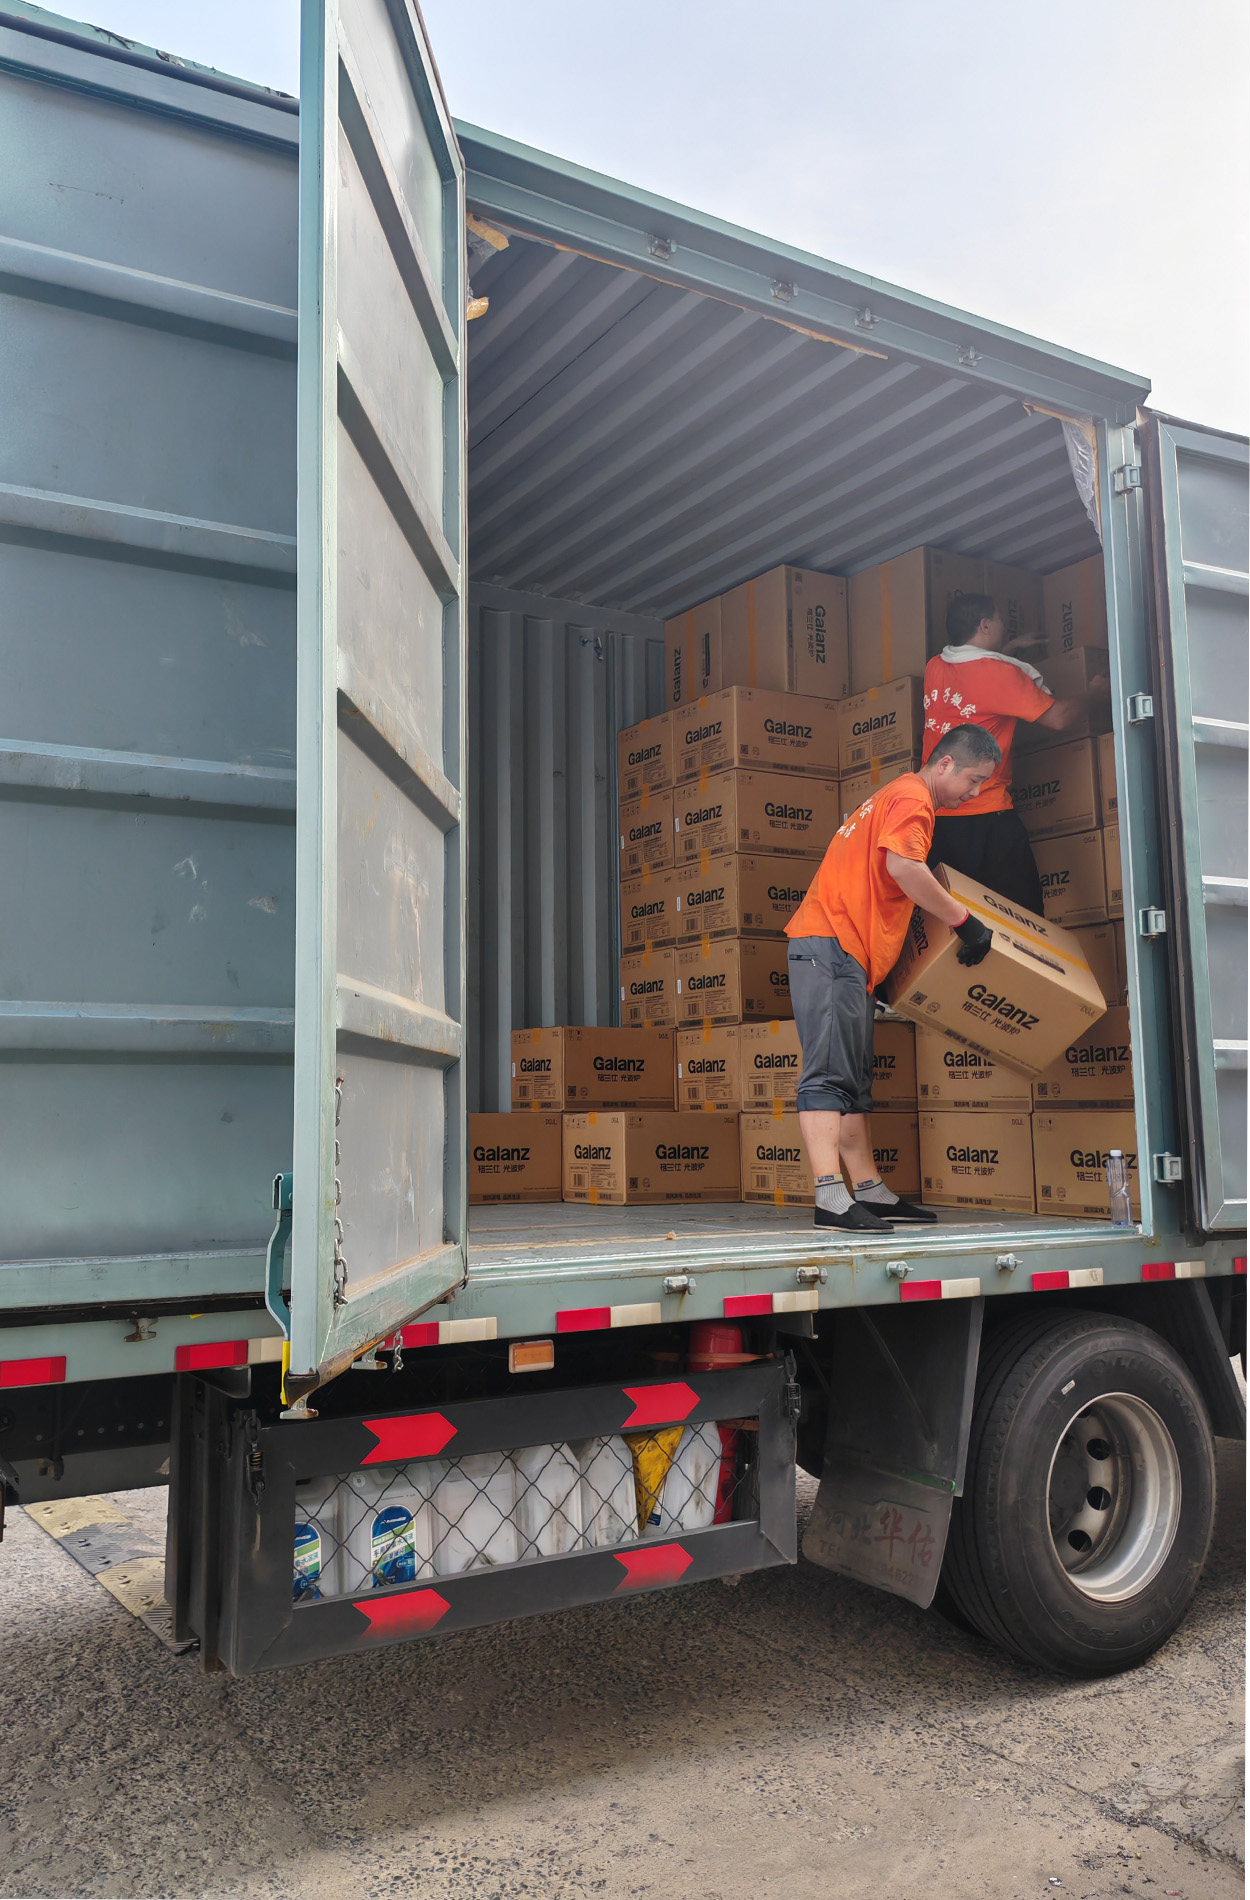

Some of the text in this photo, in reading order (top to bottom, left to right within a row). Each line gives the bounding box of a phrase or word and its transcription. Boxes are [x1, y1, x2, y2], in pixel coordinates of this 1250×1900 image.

[815, 605, 826, 664] Galanz
[1061, 601, 1073, 653] alanz
[685, 721, 723, 744] Galanz
[764, 719, 812, 739] Galanz
[852, 711, 897, 736] Galanz
[628, 743, 662, 766] Galanz
[685, 805, 723, 826] Galanz
[764, 802, 813, 822] Galanz
[629, 821, 662, 842] Galanz
[1040, 869, 1070, 887] anz
[687, 887, 725, 907] Galanz
[768, 886, 807, 902] Galan
[631, 900, 665, 919] Galanz
[983, 894, 1049, 937] Galanz
[630, 979, 664, 996] Galanz
[688, 973, 726, 991] Galanz
[961, 1001, 991, 1022] 格兰仕
[967, 984, 1040, 1031] Galanz
[593, 1055, 645, 1072] Galanz
[754, 1053, 798, 1069] Galanz
[872, 1055, 896, 1069] anz
[1065, 1045, 1130, 1064] Galanz
[520, 1058, 552, 1073] Galanz
[688, 1058, 726, 1074] Galanz
[1071, 1065, 1126, 1077] 格兰仕 光波炉
[473, 1145, 531, 1162] Galanz
[574, 1144, 612, 1160] Galanz
[655, 1144, 710, 1160] Galanz
[756, 1145, 801, 1162] Galanz
[873, 1148, 899, 1162] anz
[946, 1145, 1000, 1164] Galanz
[478, 1164, 500, 1174] 格兰仕
[951, 1165, 996, 1176] 格兰仕 光波炉
[1076, 1171, 1103, 1183] 格兰仕
